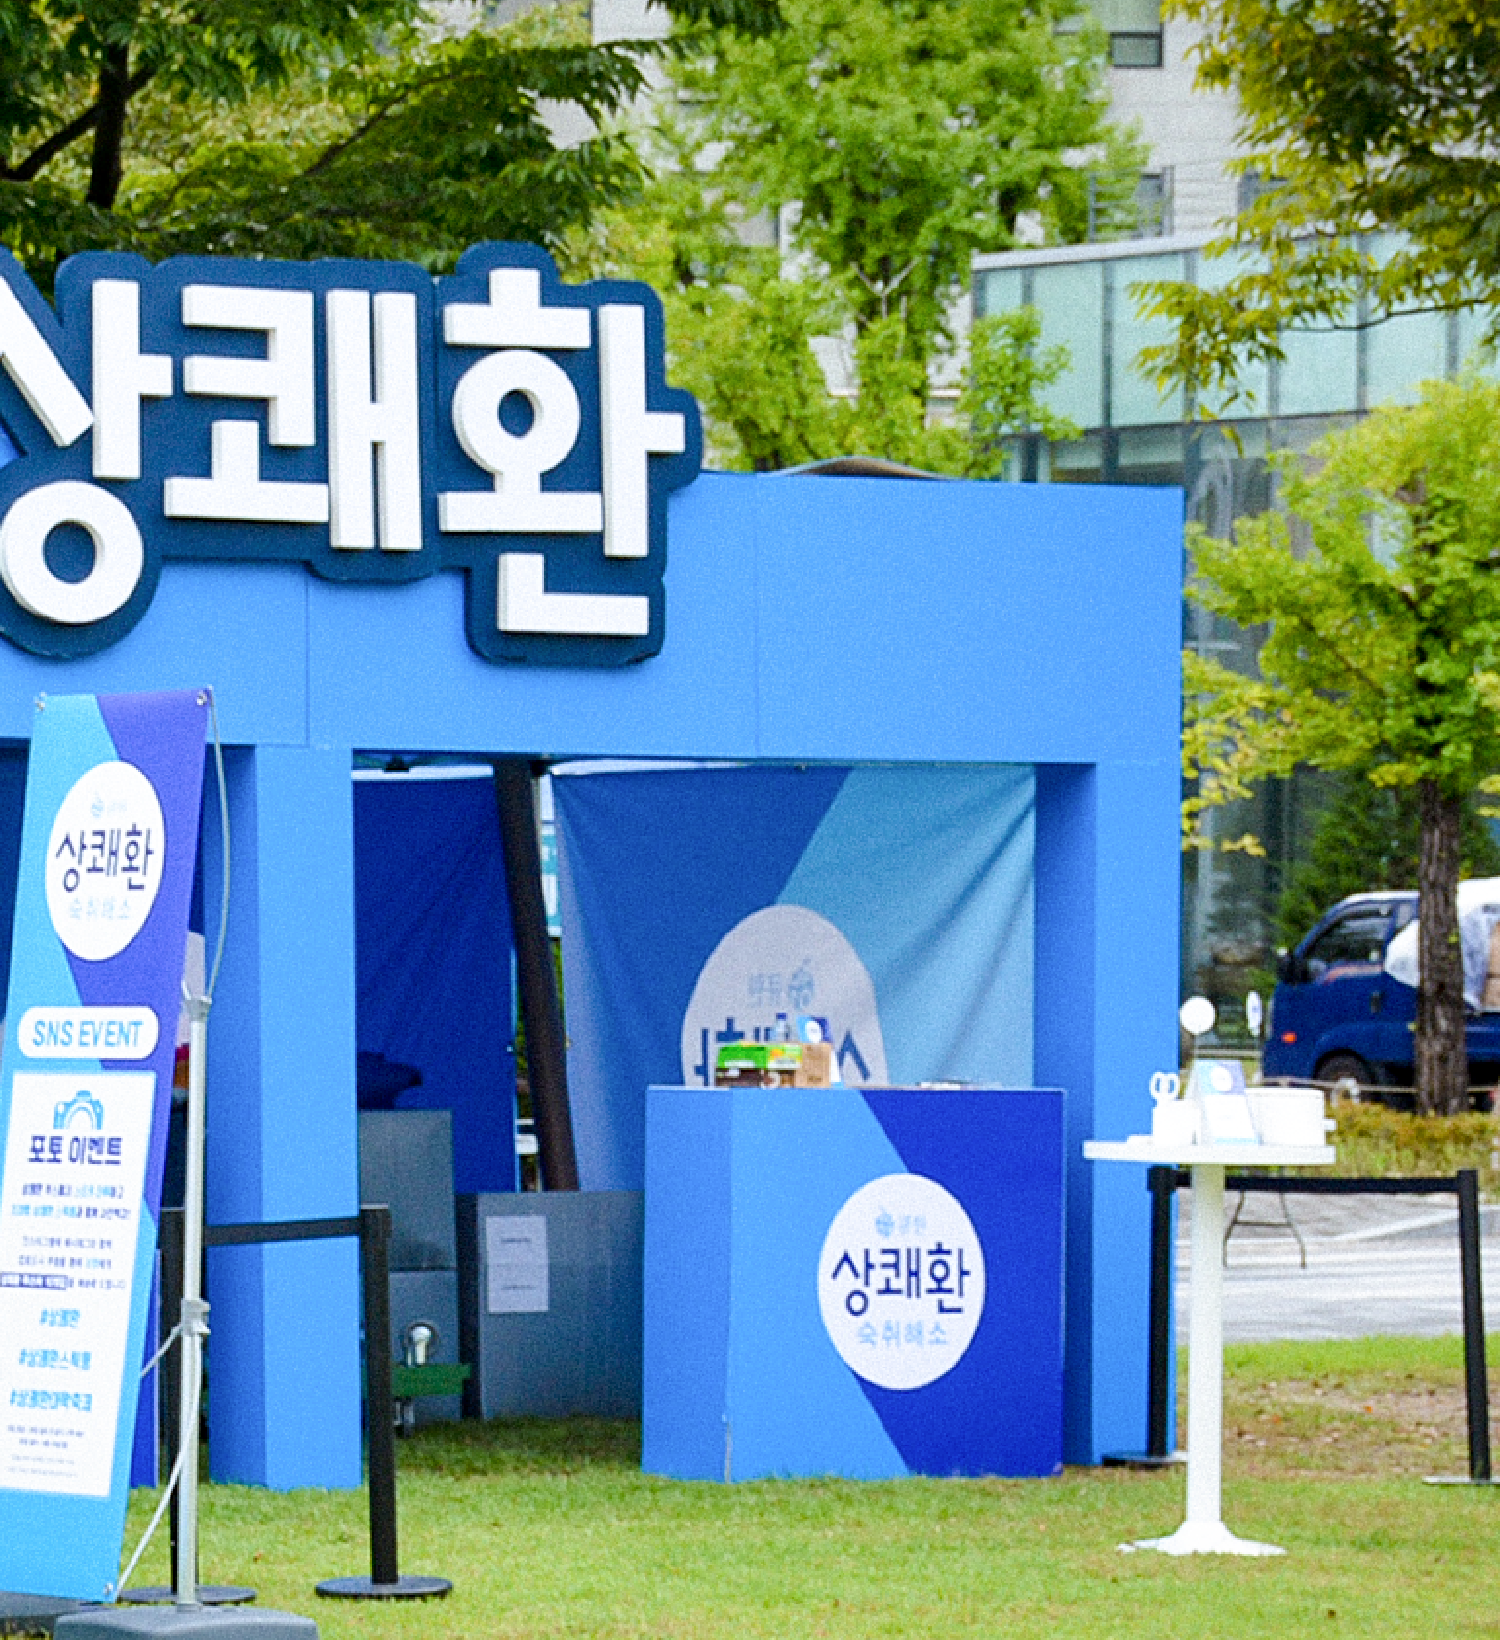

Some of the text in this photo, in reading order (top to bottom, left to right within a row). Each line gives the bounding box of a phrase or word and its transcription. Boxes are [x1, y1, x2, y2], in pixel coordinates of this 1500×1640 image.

[56, 822, 153, 893] 상쾌환
[33, 1019, 143, 1047] SNS EVENT
[28, 1136, 122, 1165] 포토 이벤트
[831, 1242, 971, 1316] 상쾌환
